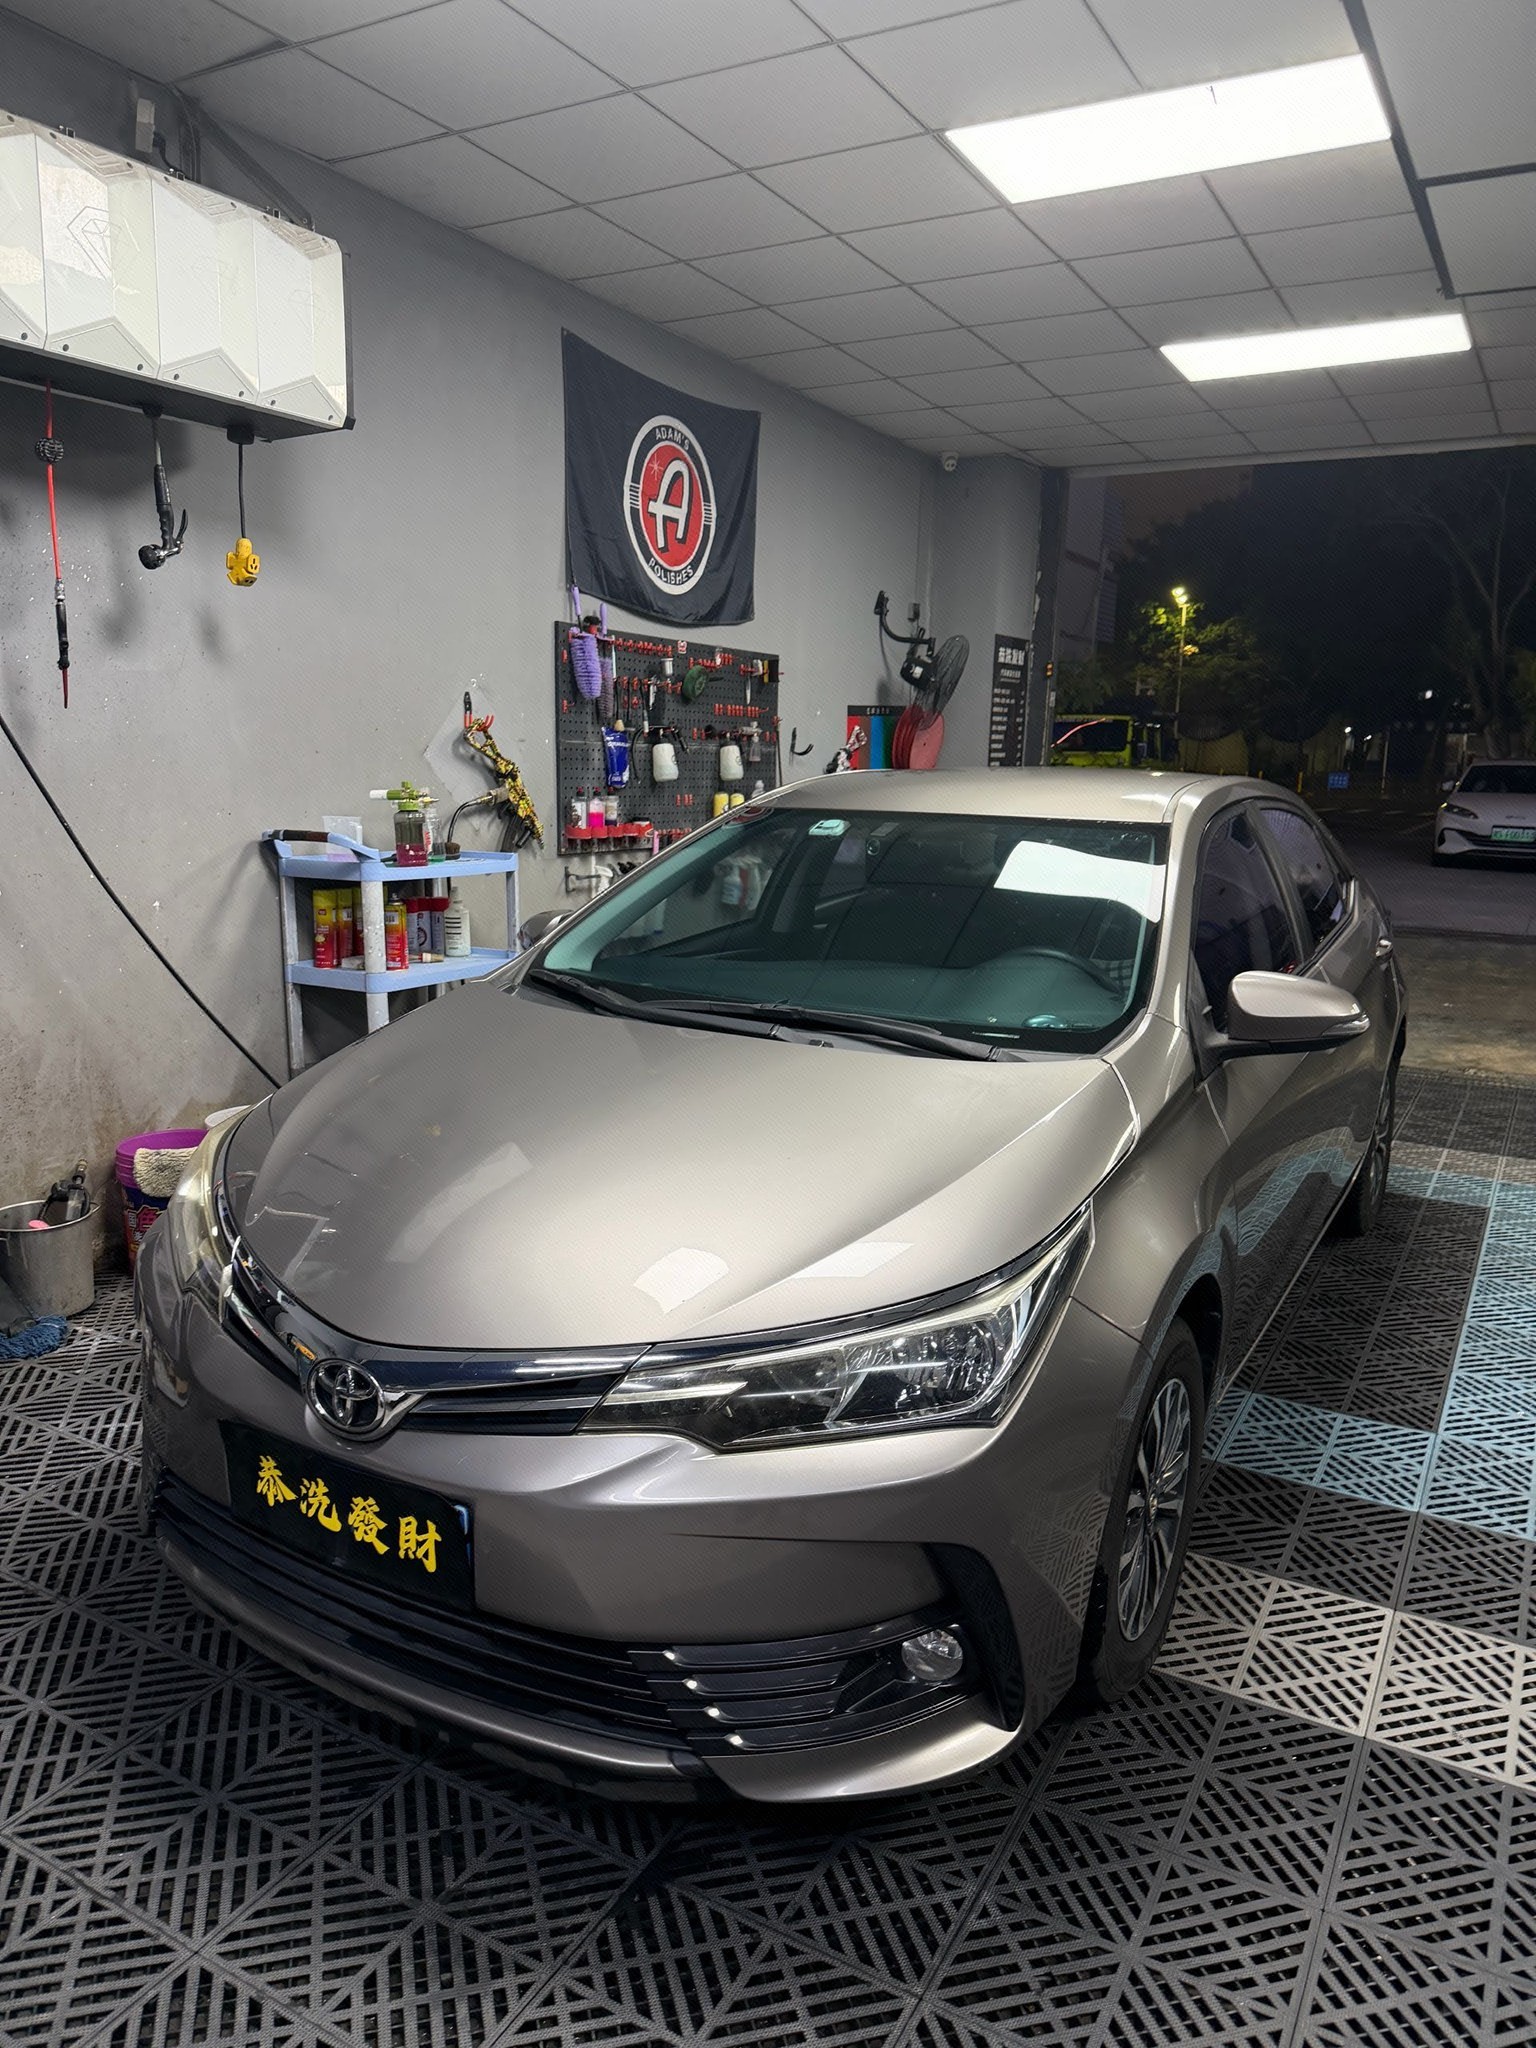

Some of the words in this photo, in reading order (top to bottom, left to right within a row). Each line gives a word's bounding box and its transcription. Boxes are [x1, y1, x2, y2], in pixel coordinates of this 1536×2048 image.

[655, 427, 690, 451] ADAM'S
[648, 459, 691, 551] A
[648, 558, 694, 584] POLISHES
